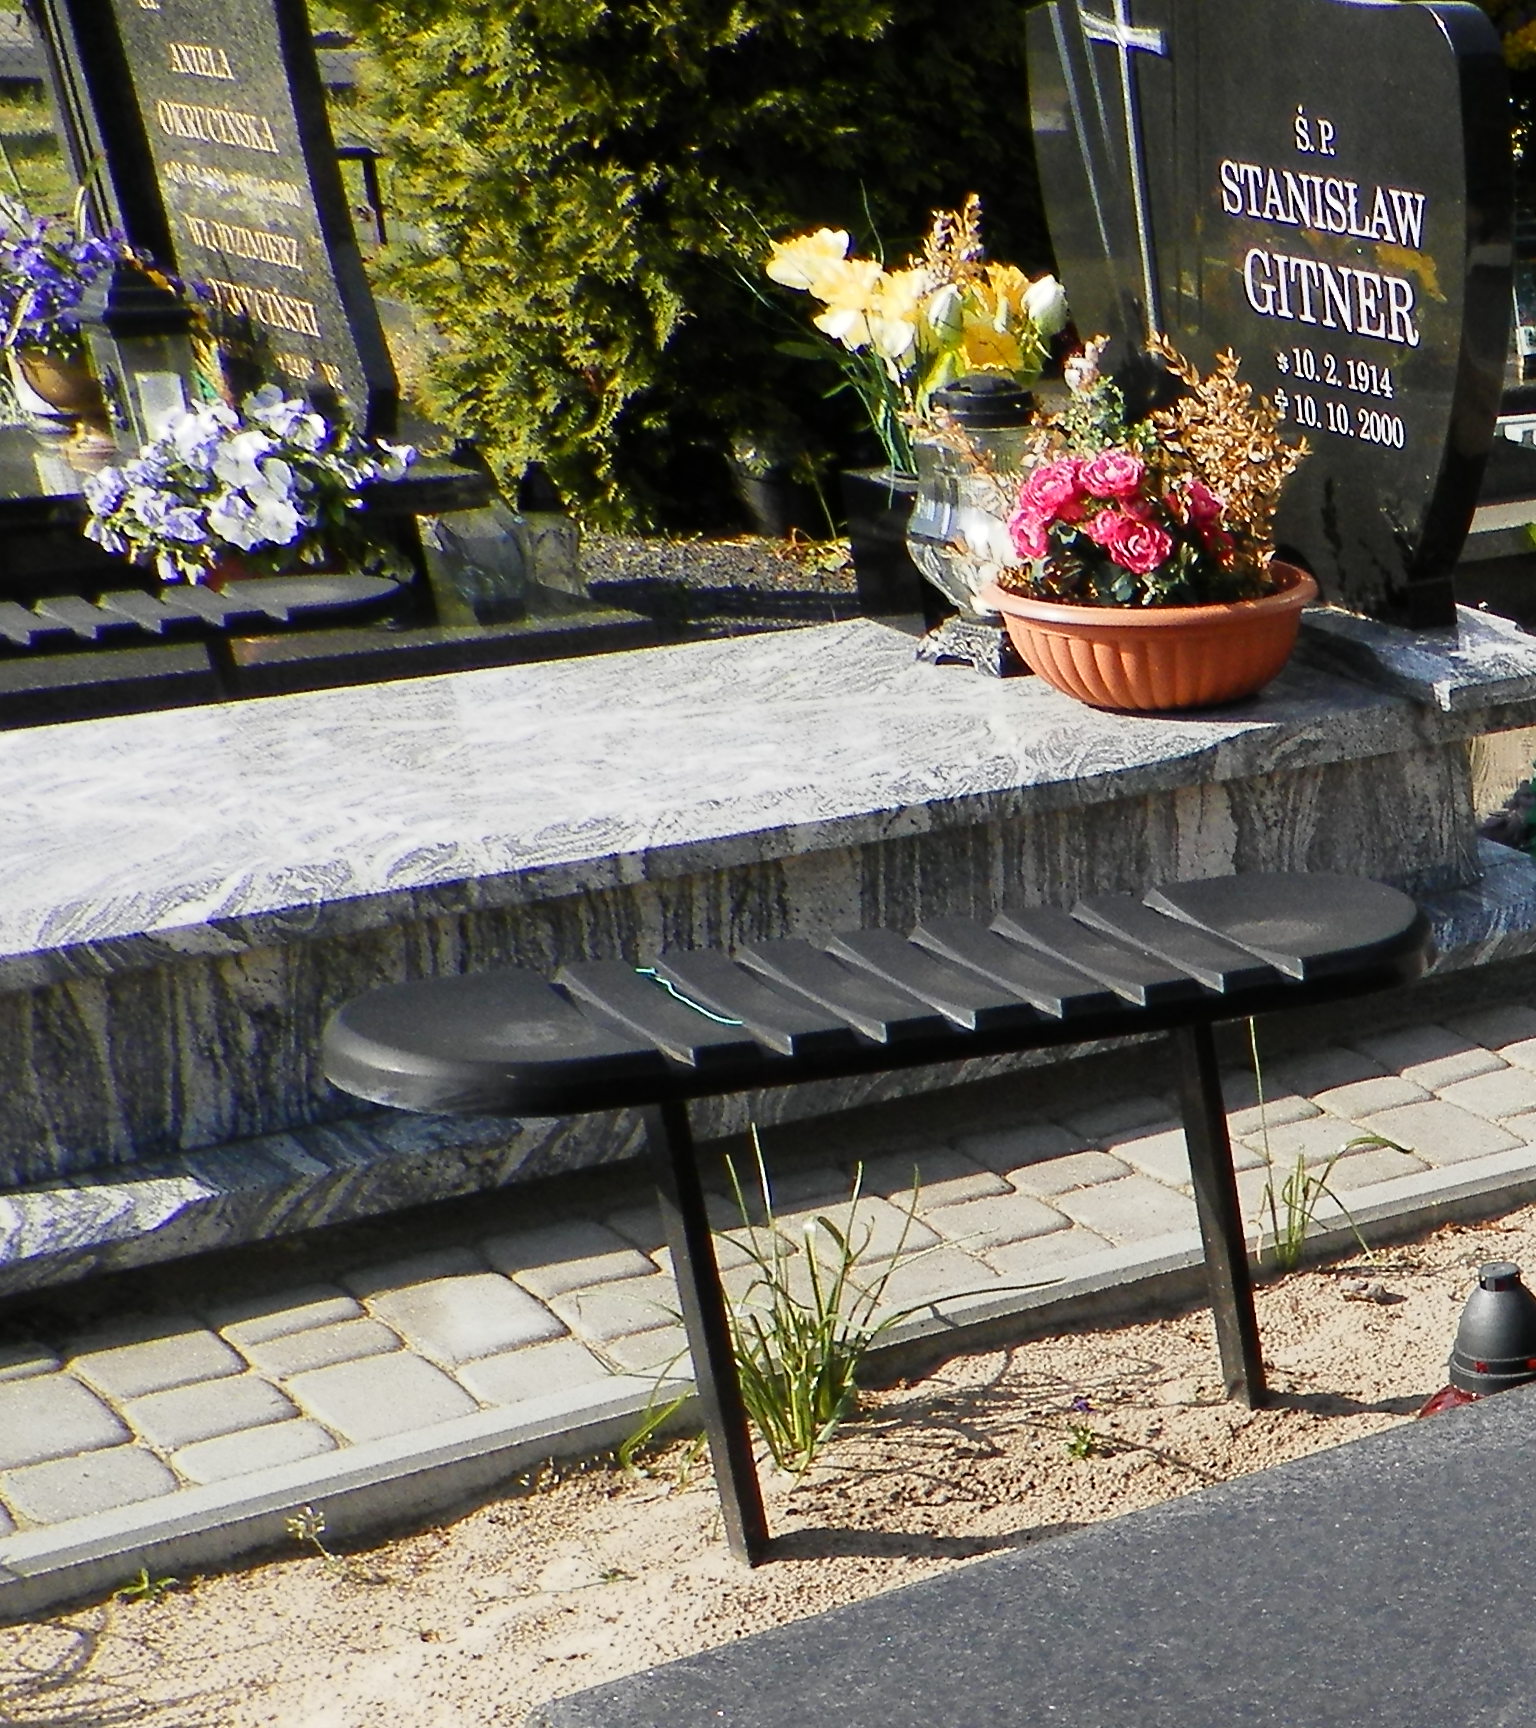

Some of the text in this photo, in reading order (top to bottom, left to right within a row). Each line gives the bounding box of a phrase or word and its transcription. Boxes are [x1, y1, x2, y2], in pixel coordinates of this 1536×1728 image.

[1220, 159, 1426, 249] STANISŁAW
[1243, 248, 1420, 347] GITNER
[1347, 360, 1393, 399] 1914
[1358, 408, 1406, 449] 2000
